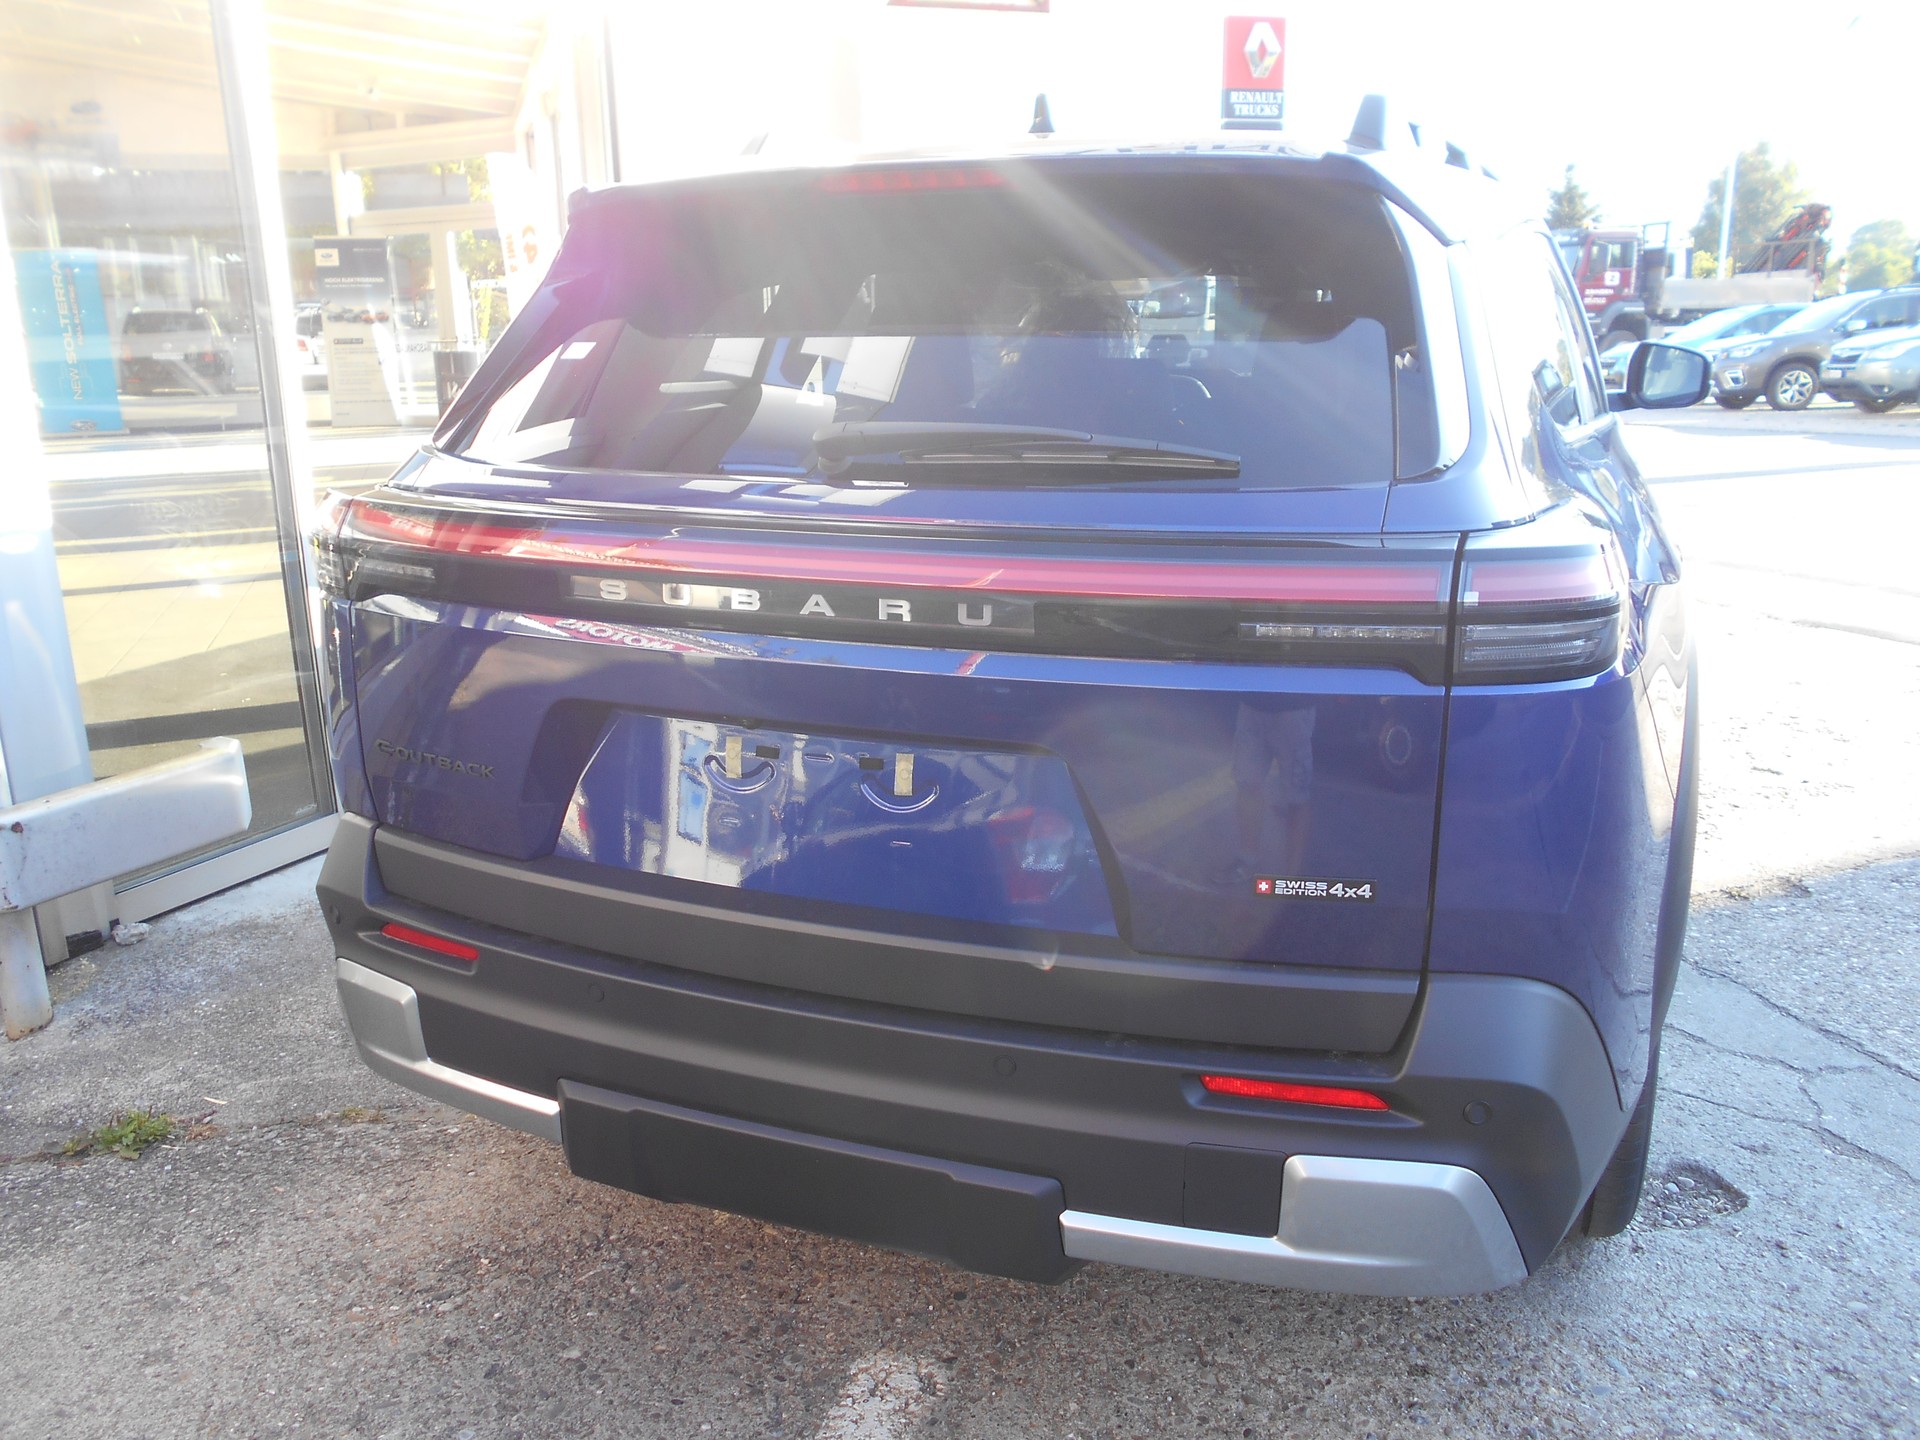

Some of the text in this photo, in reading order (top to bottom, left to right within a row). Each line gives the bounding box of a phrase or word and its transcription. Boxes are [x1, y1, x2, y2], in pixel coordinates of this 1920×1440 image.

[1230, 91, 1283, 103] RENAULT
[1234, 103, 1279, 116] TRUCKS
[50, 259, 83, 400] NEW SOLTERRA
[600, 579, 993, 627] SUBARU
[1274, 883, 1373, 899] EDITION 4x4
[1275, 880, 1328, 890] SWISS
